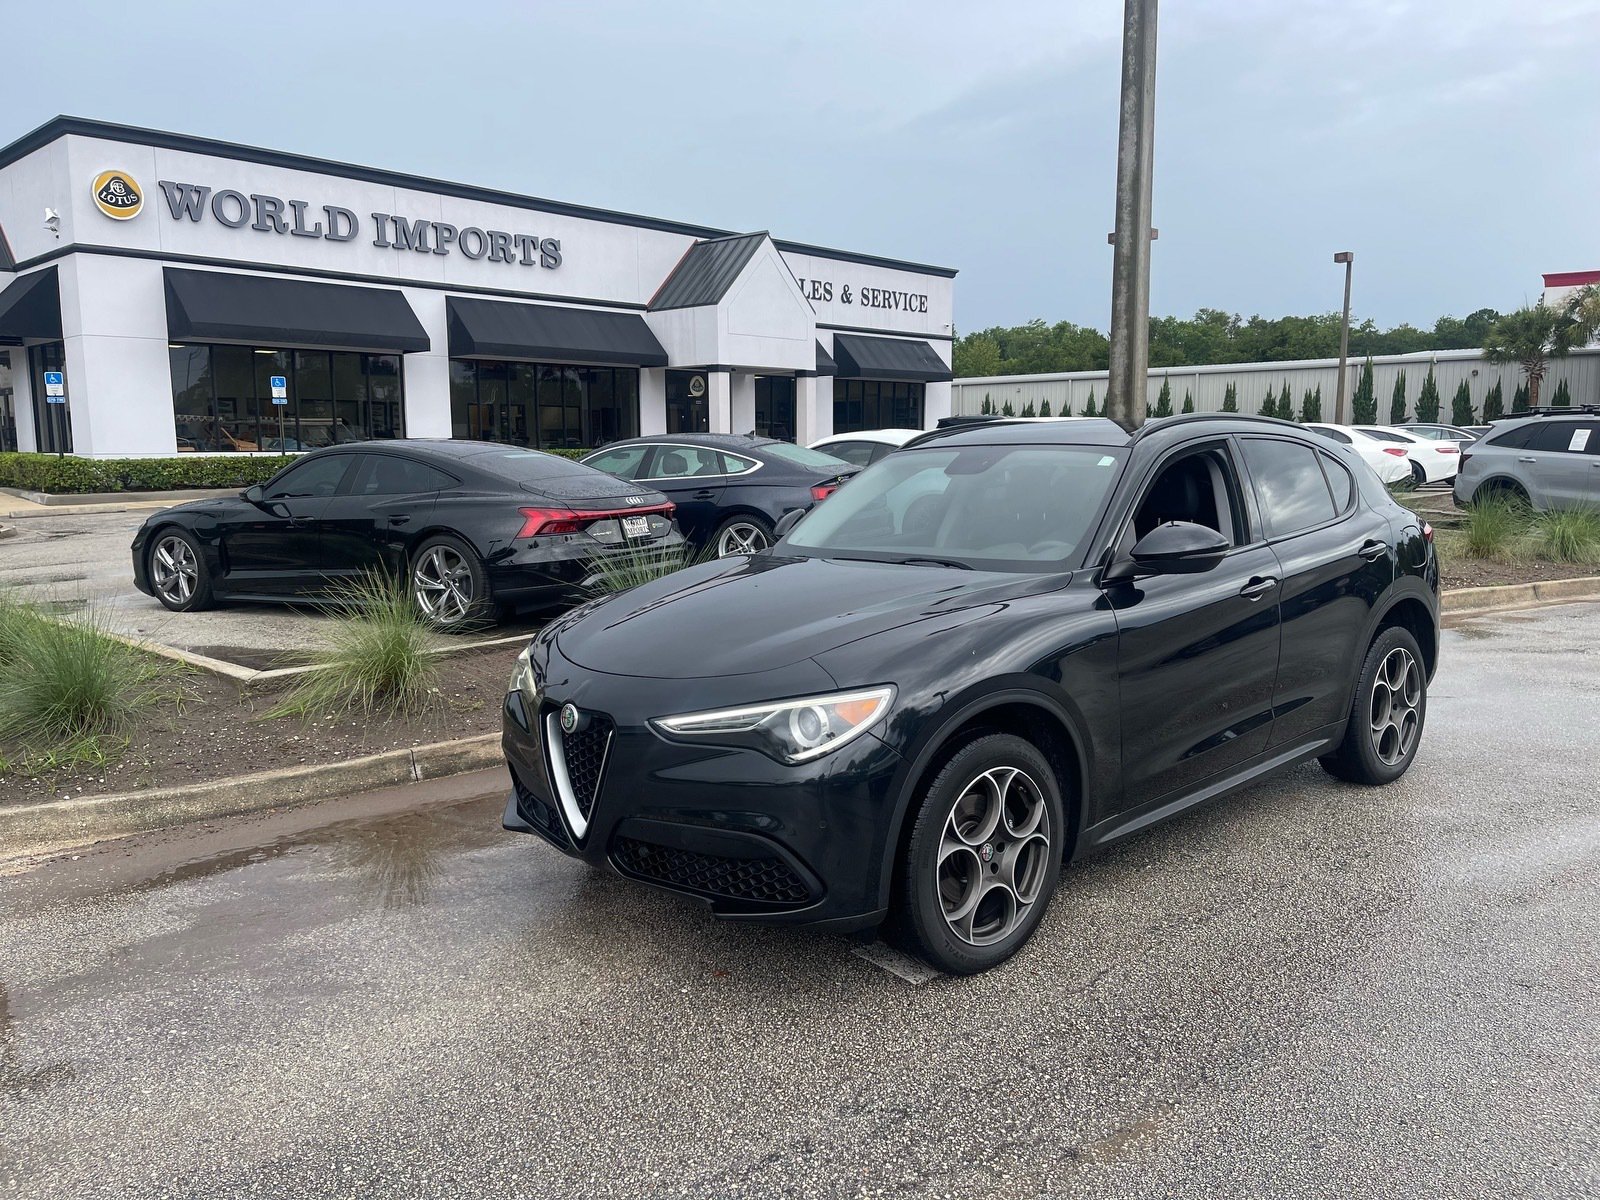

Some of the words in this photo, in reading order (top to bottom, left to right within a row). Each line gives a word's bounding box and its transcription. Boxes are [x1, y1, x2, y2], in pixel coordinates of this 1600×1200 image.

[100, 191, 137, 204] LOTUS
[158, 180, 360, 242] WORLD
[371, 212, 563, 269] IMPORTS
[798, 278, 833, 302] LES
[840, 284, 853, 304] &
[861, 287, 928, 313] SERVICE
